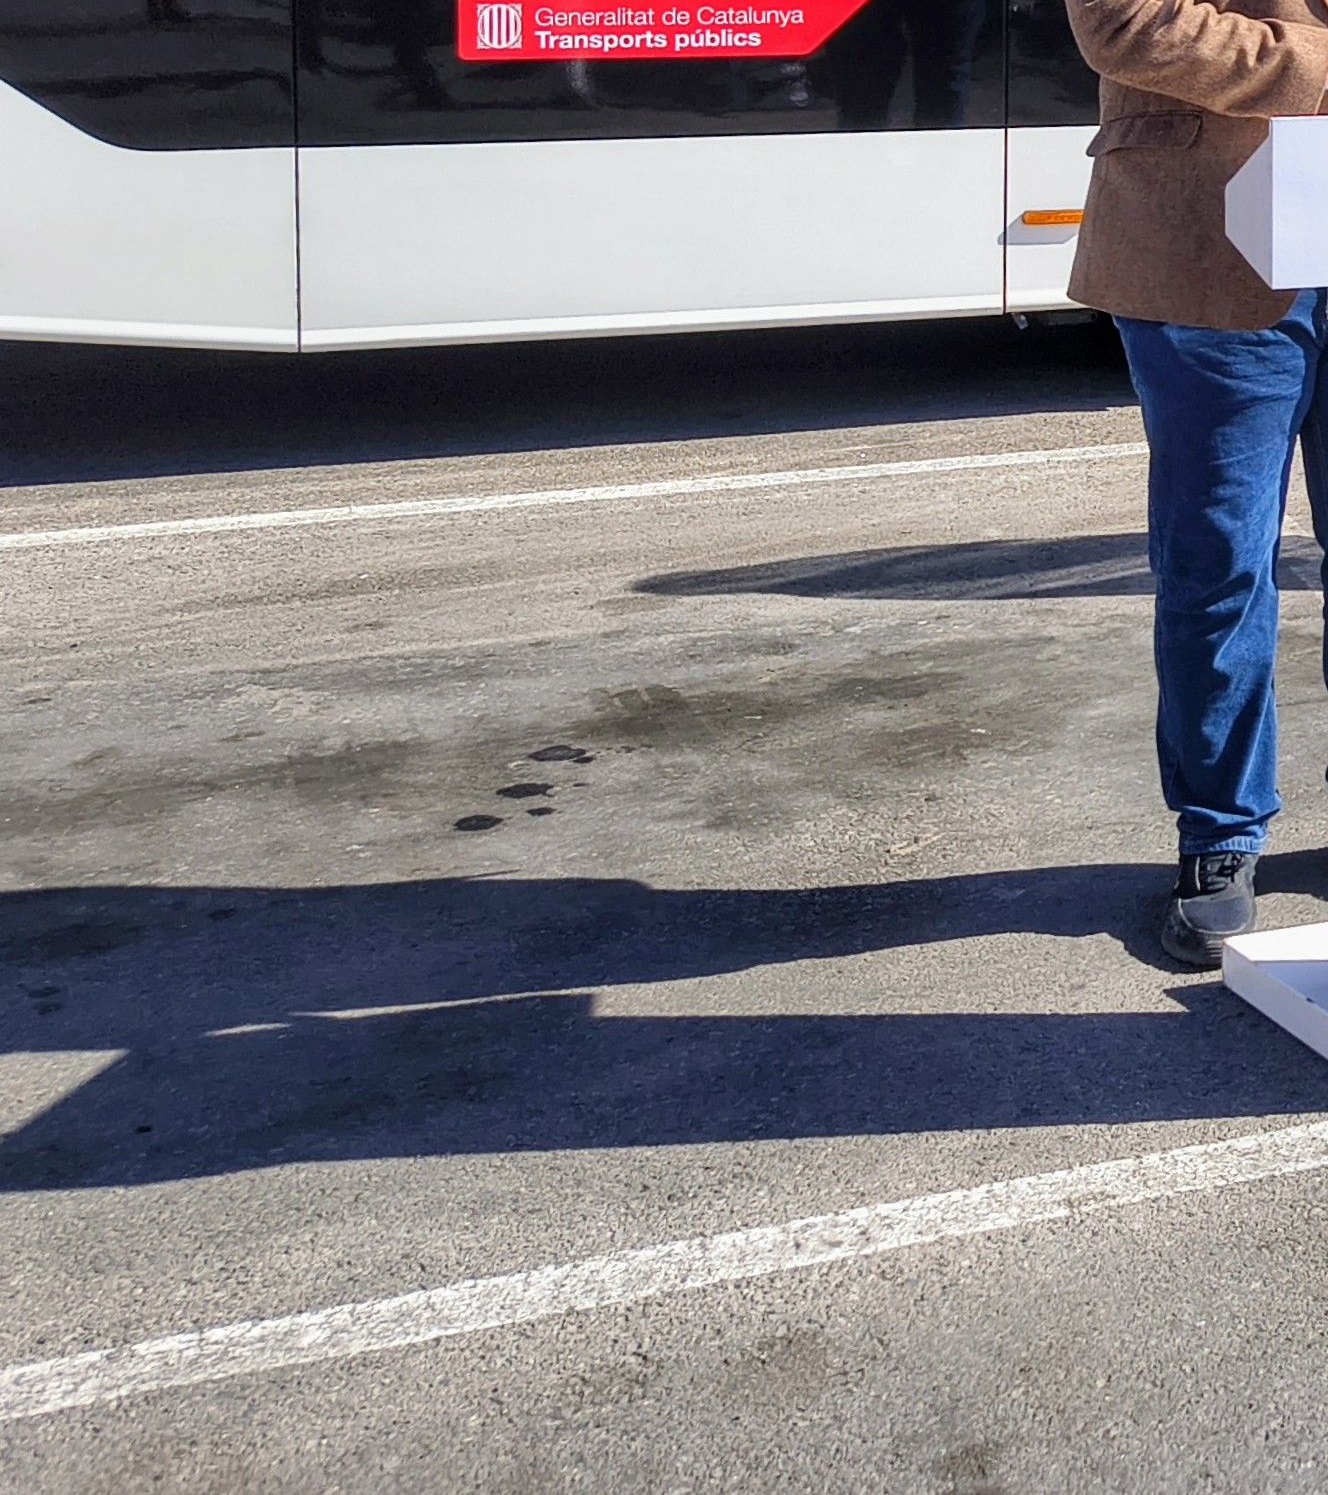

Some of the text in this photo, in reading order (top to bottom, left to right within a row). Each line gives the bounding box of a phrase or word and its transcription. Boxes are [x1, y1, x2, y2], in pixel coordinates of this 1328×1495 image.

[535, 6, 804, 28] Generalitat de Catalunya
[535, 29, 762, 53] Transports públics
